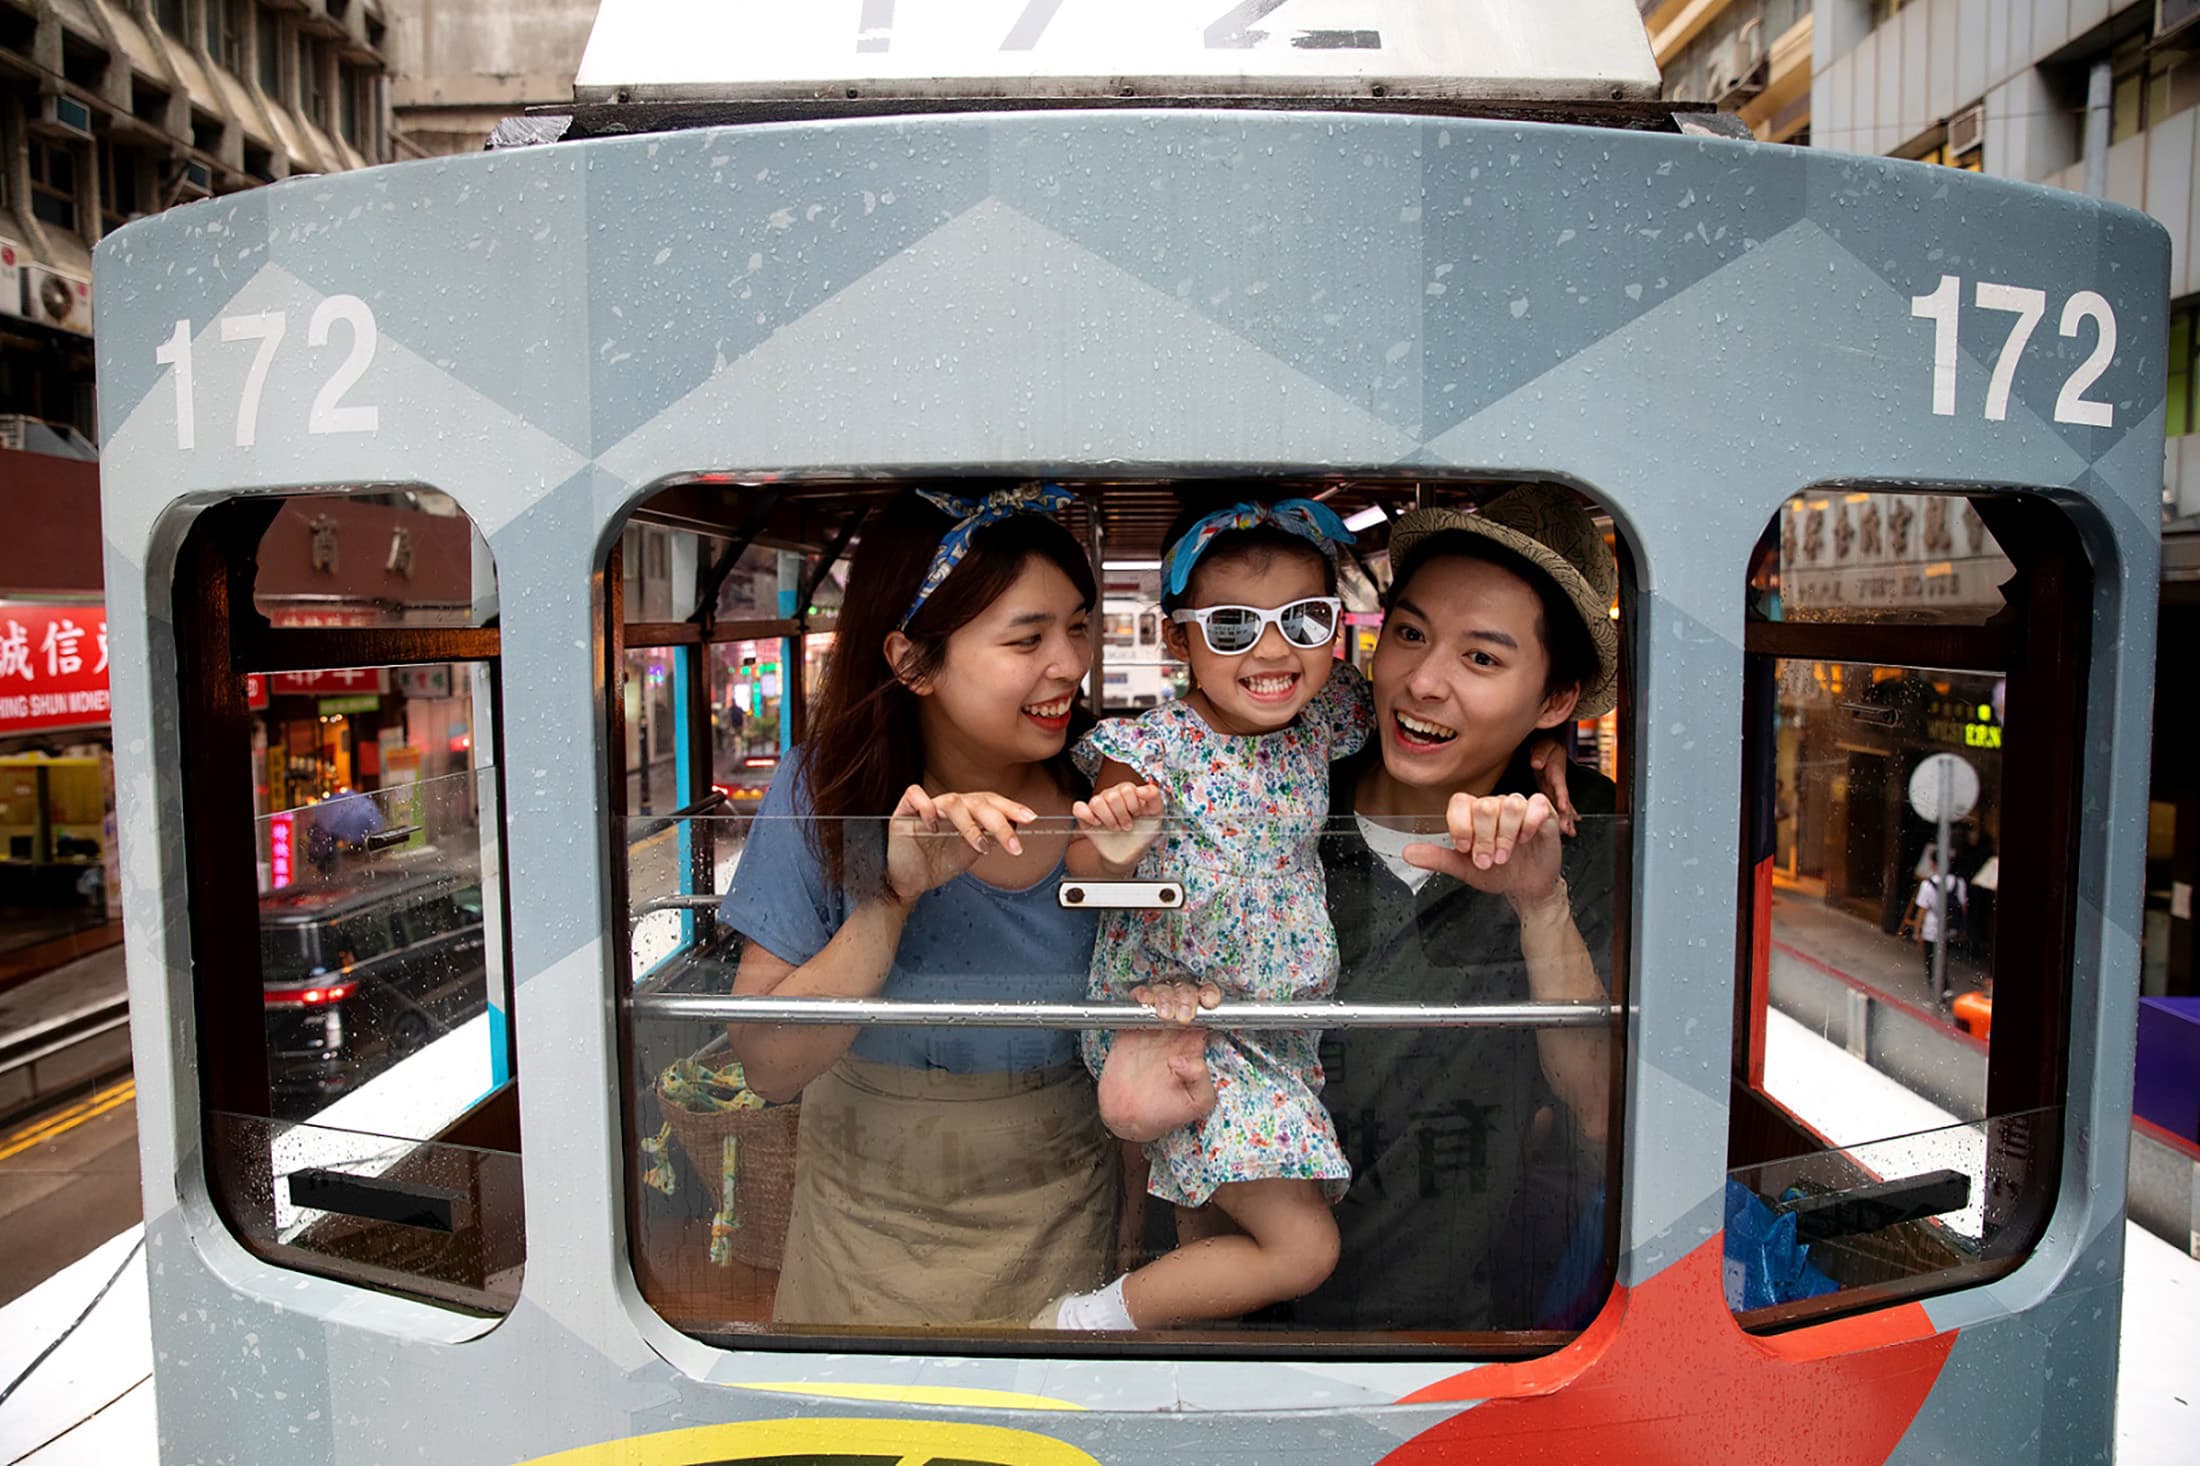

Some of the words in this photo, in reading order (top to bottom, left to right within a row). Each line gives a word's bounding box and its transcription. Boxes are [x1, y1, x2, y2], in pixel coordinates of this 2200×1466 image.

[155, 293, 379, 450] 172
[1911, 274, 2117, 428] 172
[0, 618, 109, 681] 誠信
[29, 692, 68, 717] SHUN
